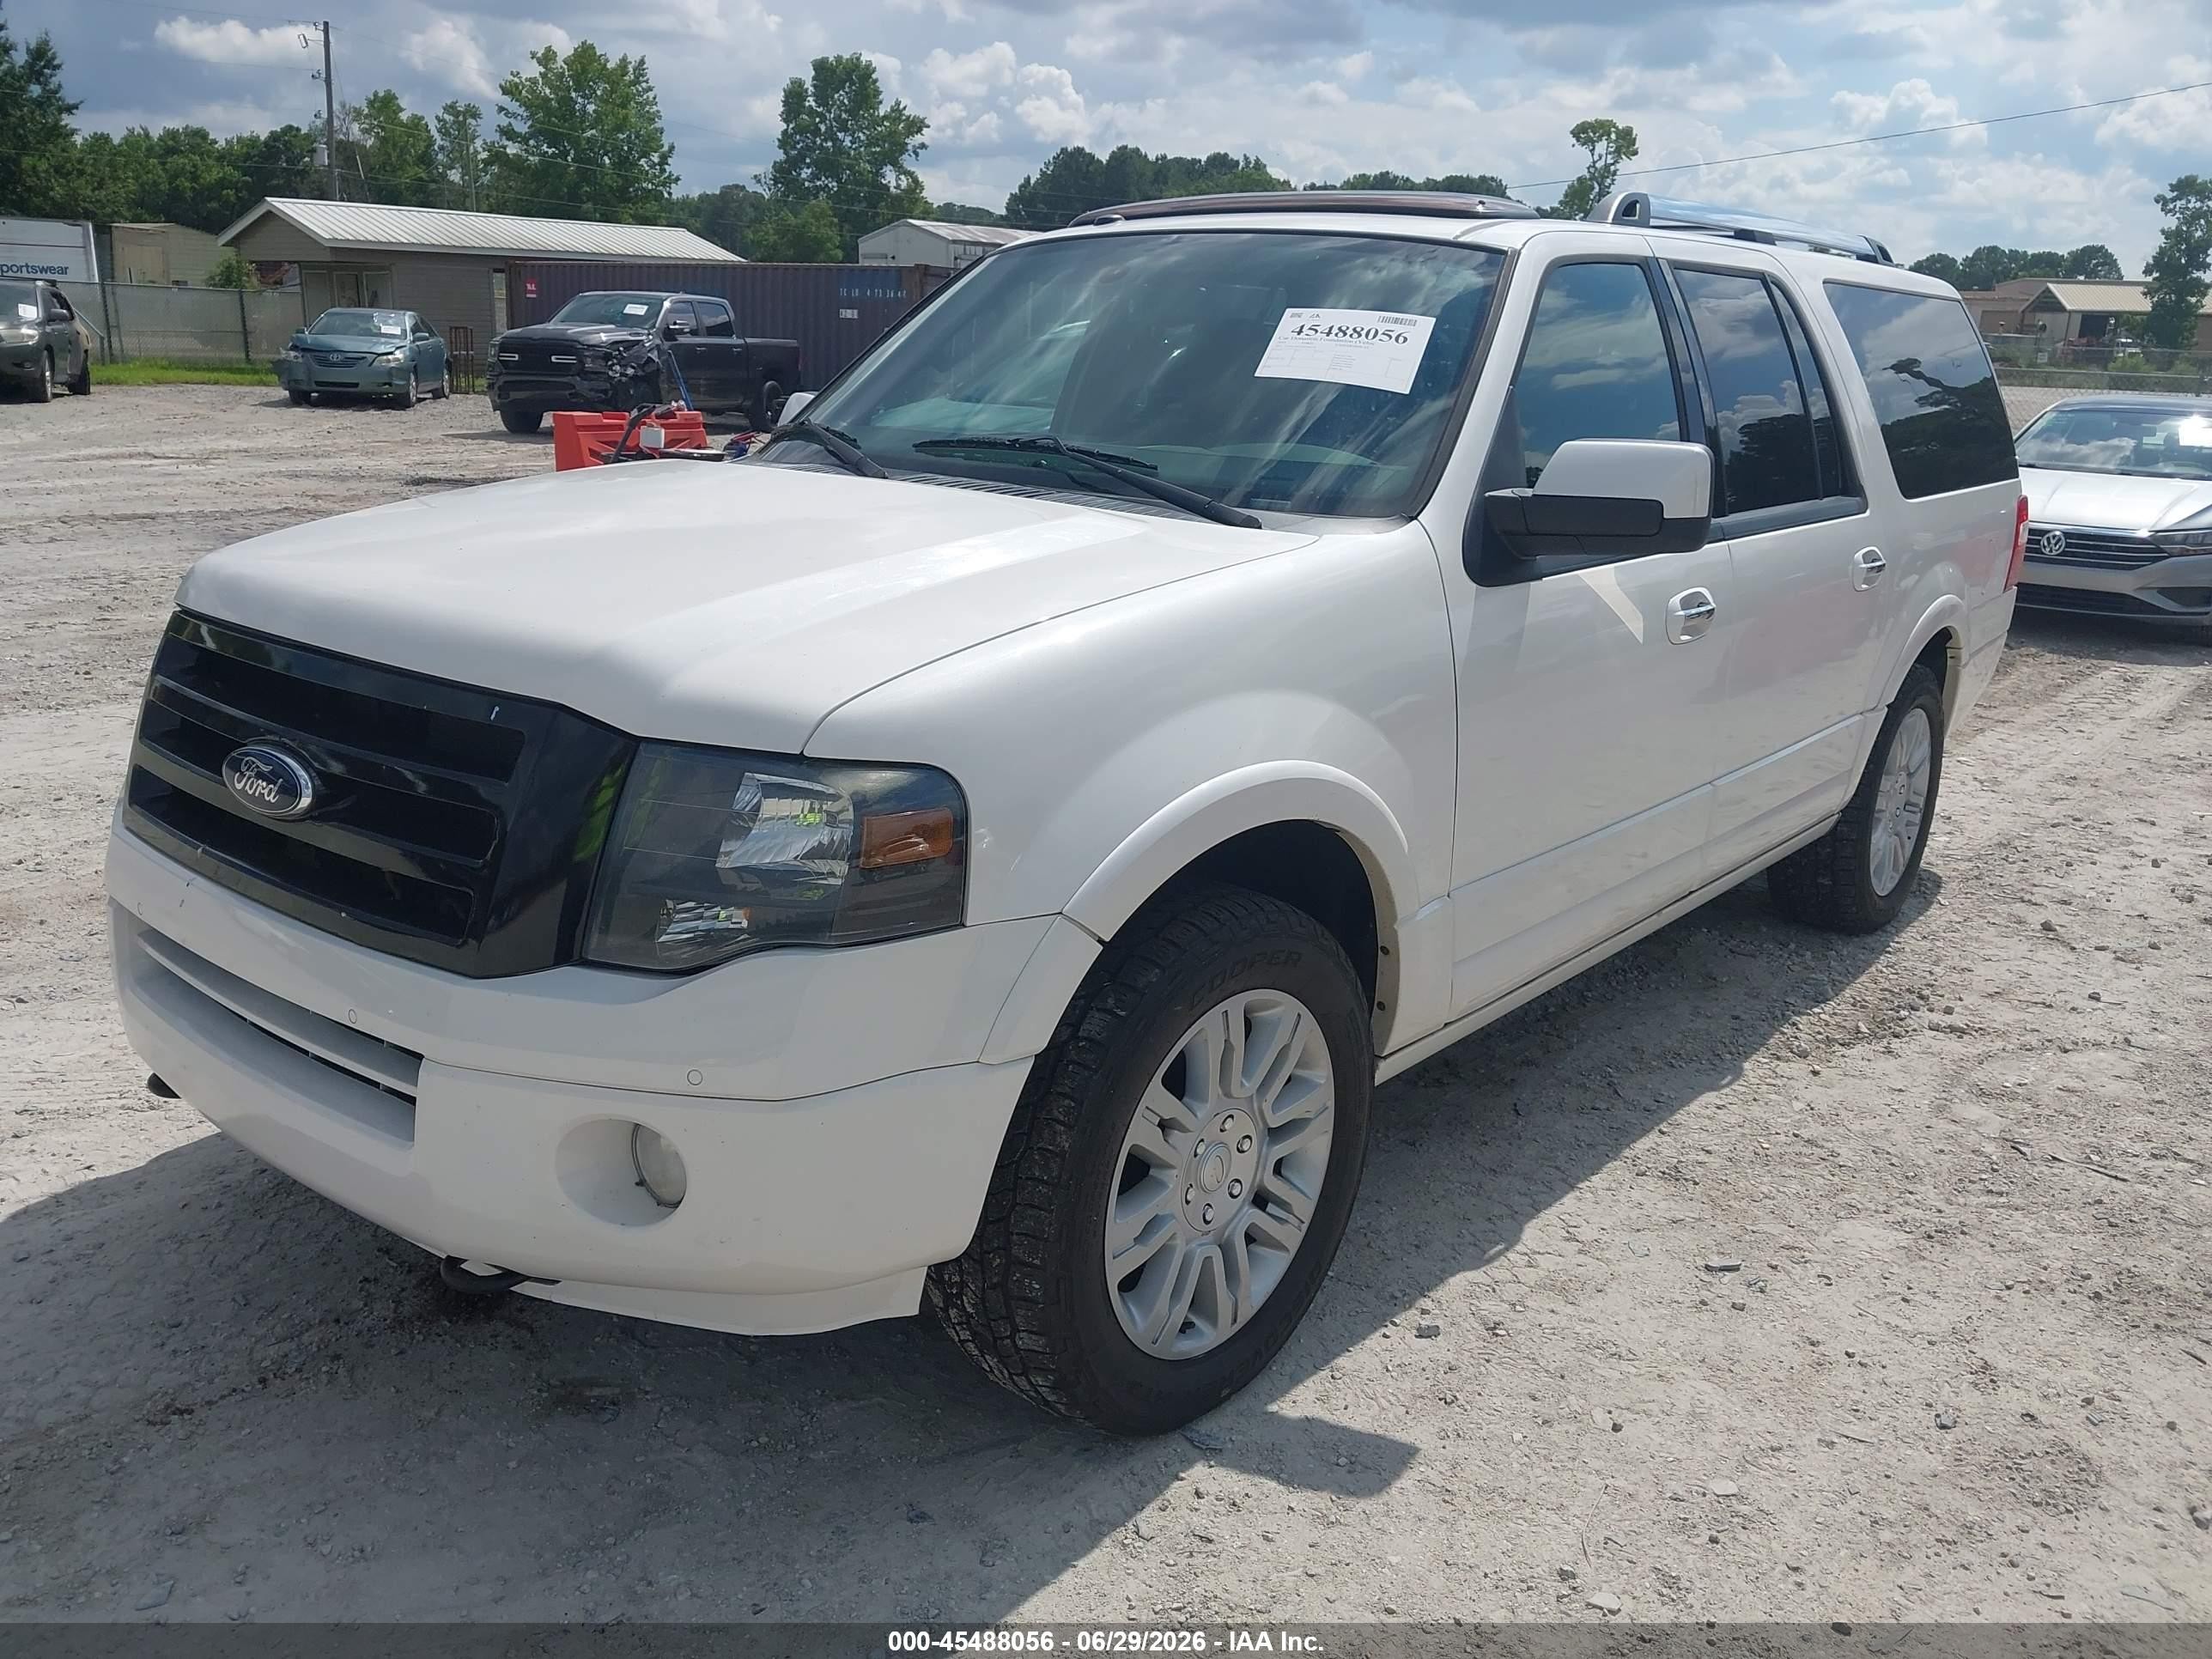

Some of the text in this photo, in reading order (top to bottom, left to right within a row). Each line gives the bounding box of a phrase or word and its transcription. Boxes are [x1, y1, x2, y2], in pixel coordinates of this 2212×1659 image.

[1291, 323, 1410, 345] 45488056
[234, 756, 283, 803] Ford
[1189, 948, 1303, 1009] COOPER
